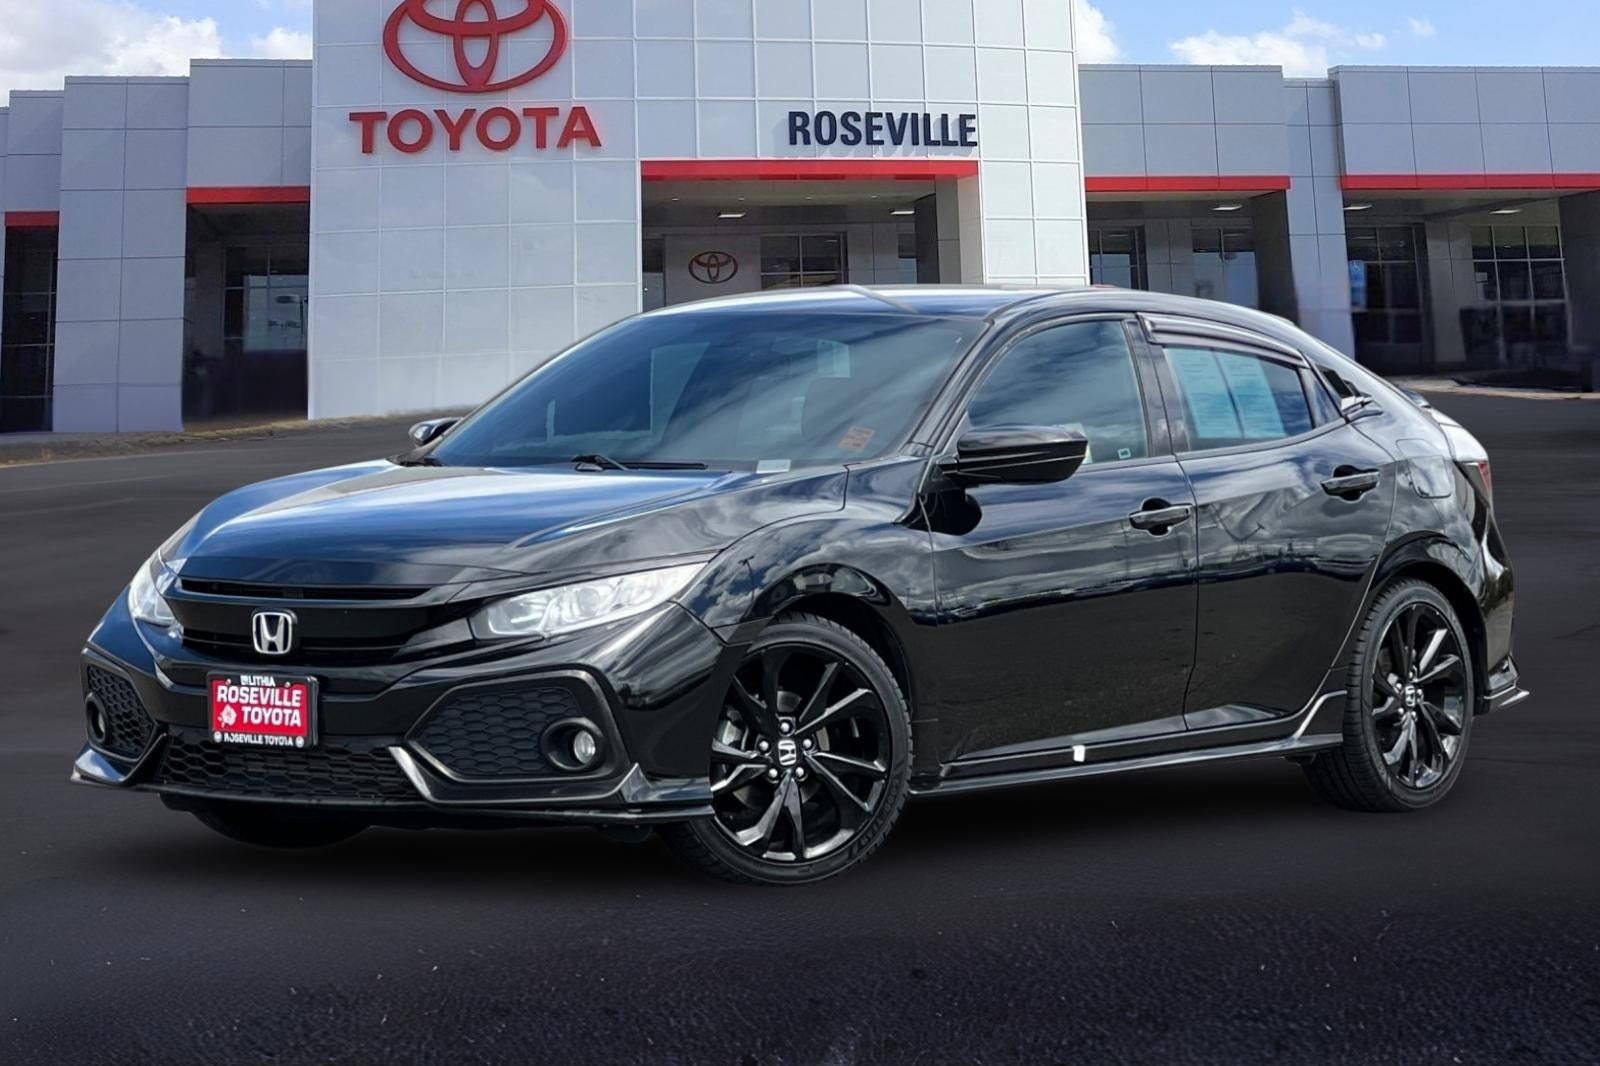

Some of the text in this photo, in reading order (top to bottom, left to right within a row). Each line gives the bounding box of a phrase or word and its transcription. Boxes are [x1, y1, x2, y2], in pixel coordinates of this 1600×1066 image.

[349, 106, 602, 154] TOYOTA
[788, 110, 978, 147] ROSEVILLE
[217, 686, 301, 707] ROSEVILLE
[242, 706, 301, 727] TOYOTA
